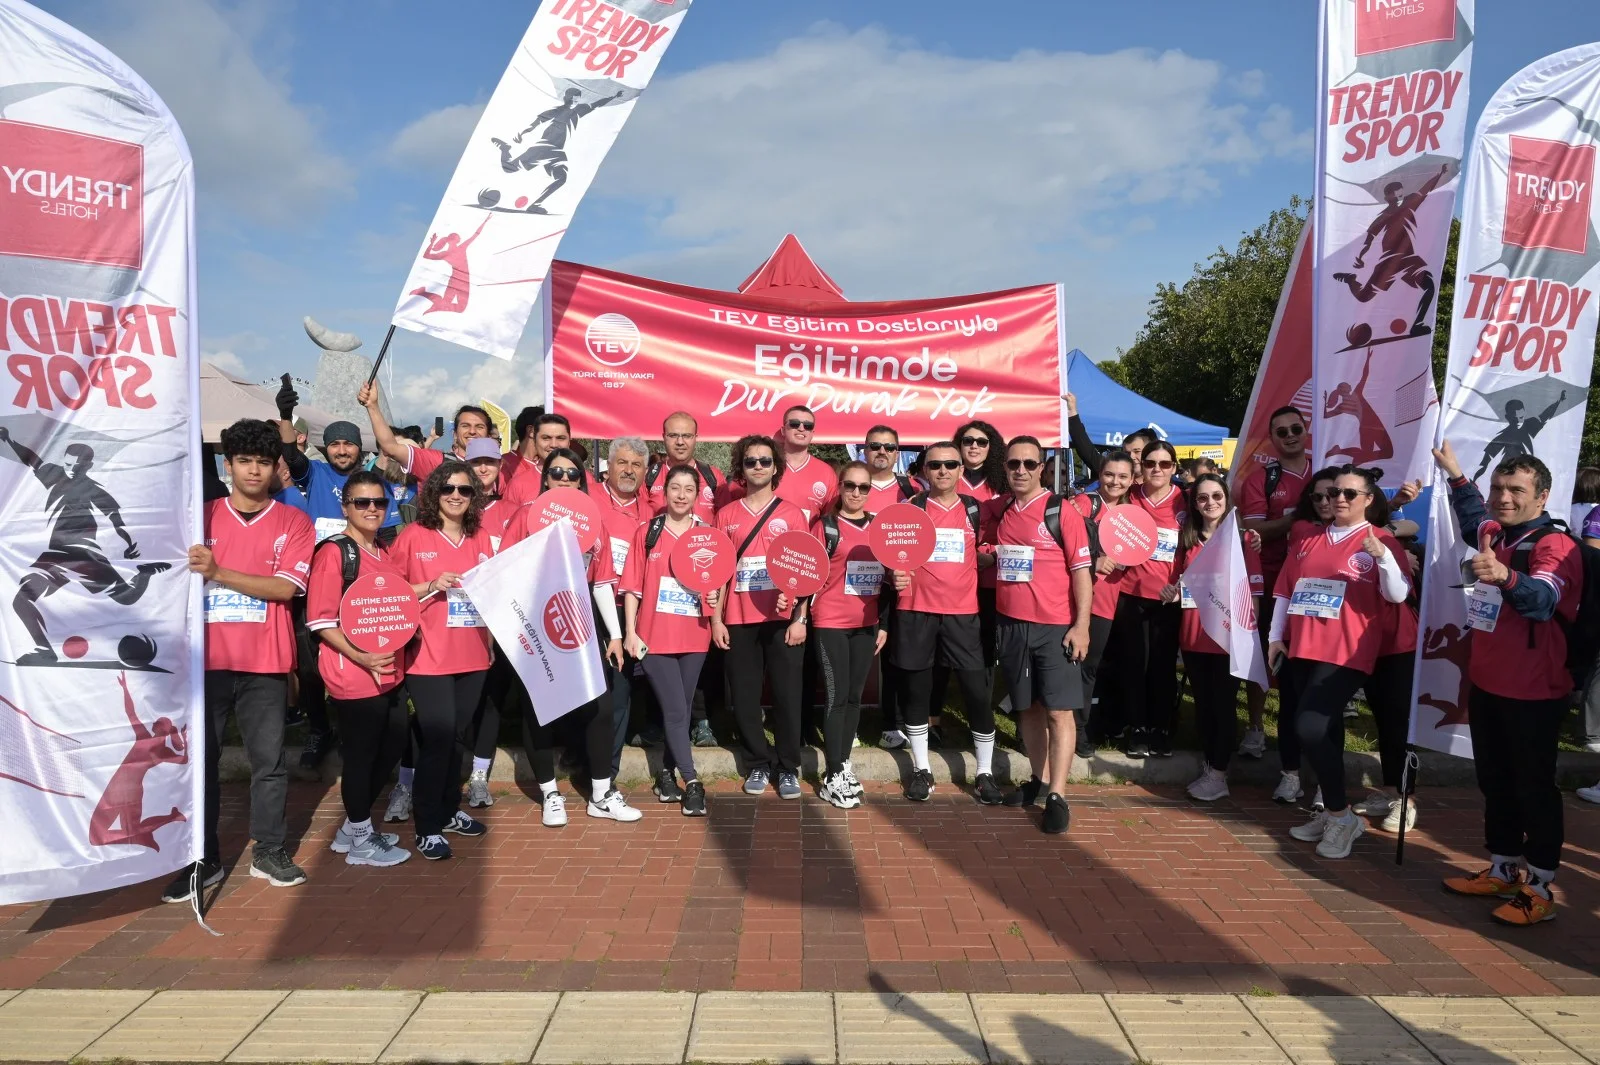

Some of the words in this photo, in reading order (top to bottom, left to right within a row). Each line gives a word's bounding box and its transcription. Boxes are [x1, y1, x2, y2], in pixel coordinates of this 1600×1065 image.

[1386, 2, 1425, 19] HOTELS
[547, 25, 638, 78] SPOR
[1329, 70, 1463, 126] TRENDY
[1342, 111, 1445, 163] SPOR
[1463, 274, 1591, 329] TRENDY
[709, 308, 758, 326] TEV
[768, 315, 849, 333] Eğitim
[857, 314, 998, 337] Dostlarıyla
[591, 340, 634, 354] TEV
[1469, 323, 1567, 373] SPOR
[754, 343, 957, 387] Eğitimde
[572, 370, 597, 378] TÜRK
[630, 372, 655, 380] VAKFI
[602, 381, 625, 389] 1967
[711, 378, 796, 417] Dur
[804, 381, 920, 417] Durak
[930, 385, 998, 420] Yok
[1253, 451, 1280, 464] TÜR
[550, 502, 574, 516] Eğitim
[580, 523, 590, 531] da
[1117, 512, 1151, 543] Tempomuzu
[691, 534, 711, 543] TEV
[888, 530, 916, 538] gelecek
[936, 541, 961, 550] 494
[781, 554, 802, 567] eğitim
[783, 546, 818, 565] Yorgunluk,
[999, 559, 1030, 568] 12472
[738, 568, 768, 579] 1249
[851, 574, 882, 583] 12489
[351, 597, 381, 606] EĞİTİME
[382, 595, 411, 603] DESTEK
[1296, 592, 1339, 604] 12487
[362, 606, 378, 615] İÇİN
[452, 602, 476, 612] 124
[358, 615, 407, 624] KOŞUYORUM,
[548, 600, 576, 645] TEV
[351, 626, 377, 635] OYNAT
[379, 623, 414, 632] BAKALIM!
[510, 599, 528, 624] TÜRK
[541, 655, 555, 682] VAKFI
[517, 633, 535, 656] 1967
